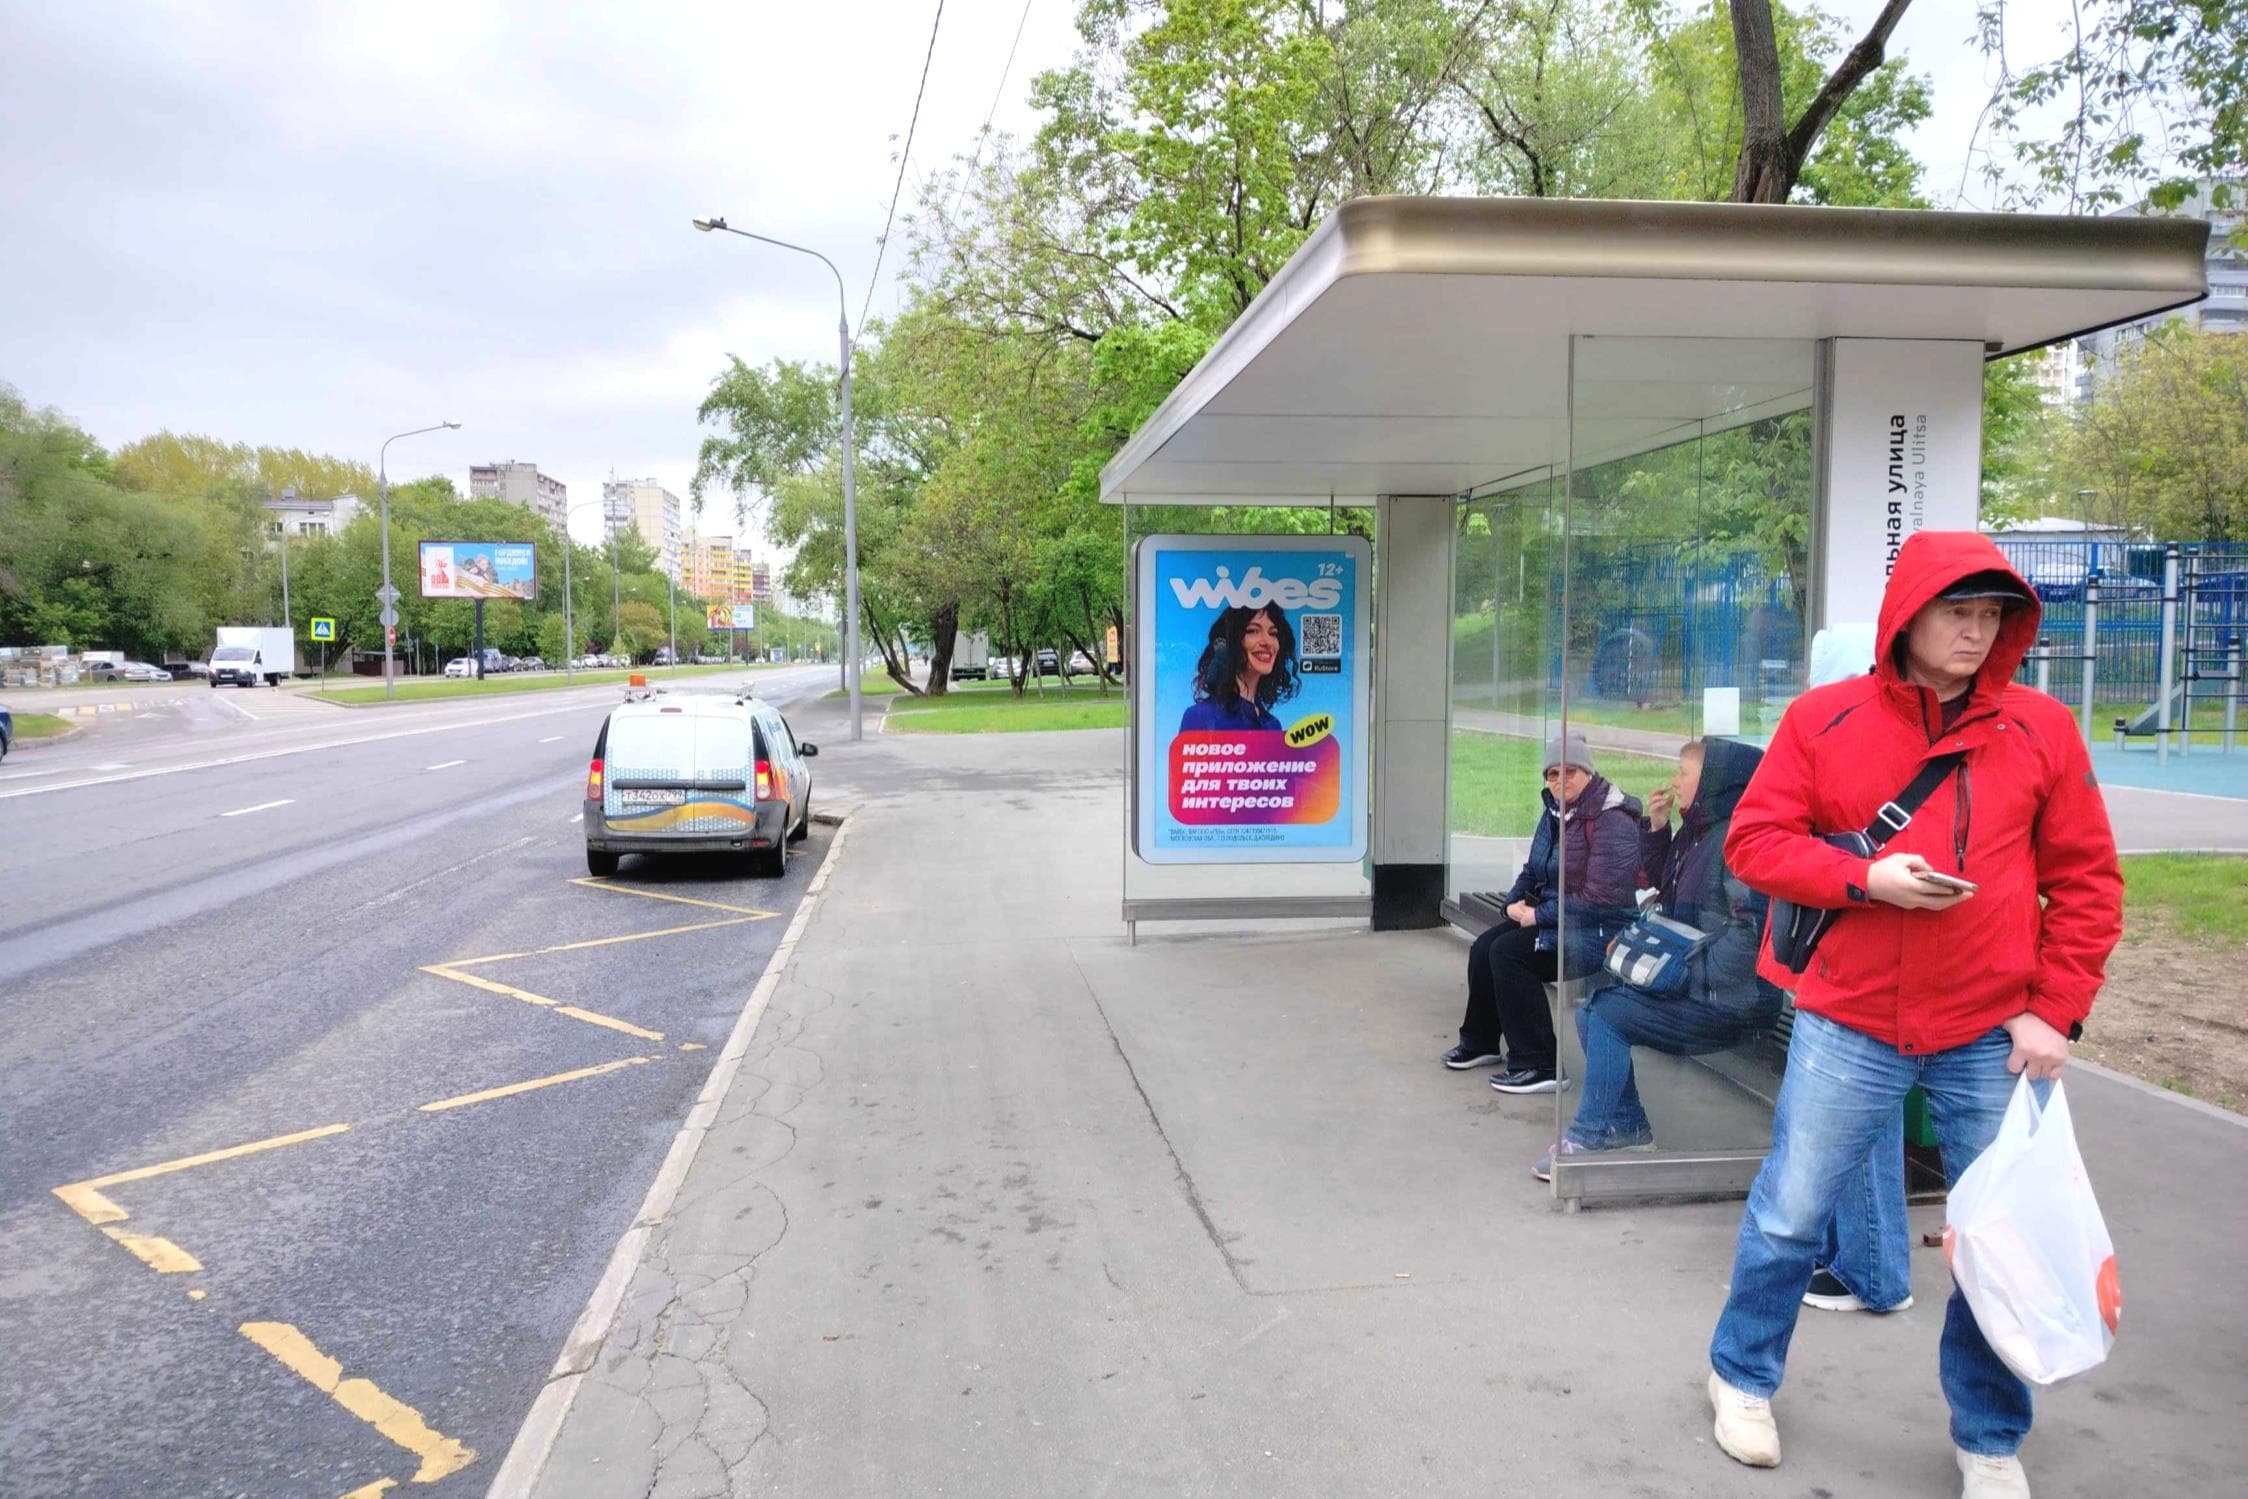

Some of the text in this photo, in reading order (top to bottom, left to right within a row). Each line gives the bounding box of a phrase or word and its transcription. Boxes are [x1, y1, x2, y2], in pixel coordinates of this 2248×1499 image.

[1911, 415, 1927, 465] Ulitsa
[1889, 415, 1907, 493] улица
[1318, 563, 1344, 576] 12+
[1169, 566, 1343, 609] wibes
[1182, 743, 1246, 756] новое
[1182, 760, 1317, 777] приложение
[1181, 778, 1288, 793] для твоих
[1182, 796, 1294, 813] интересов
